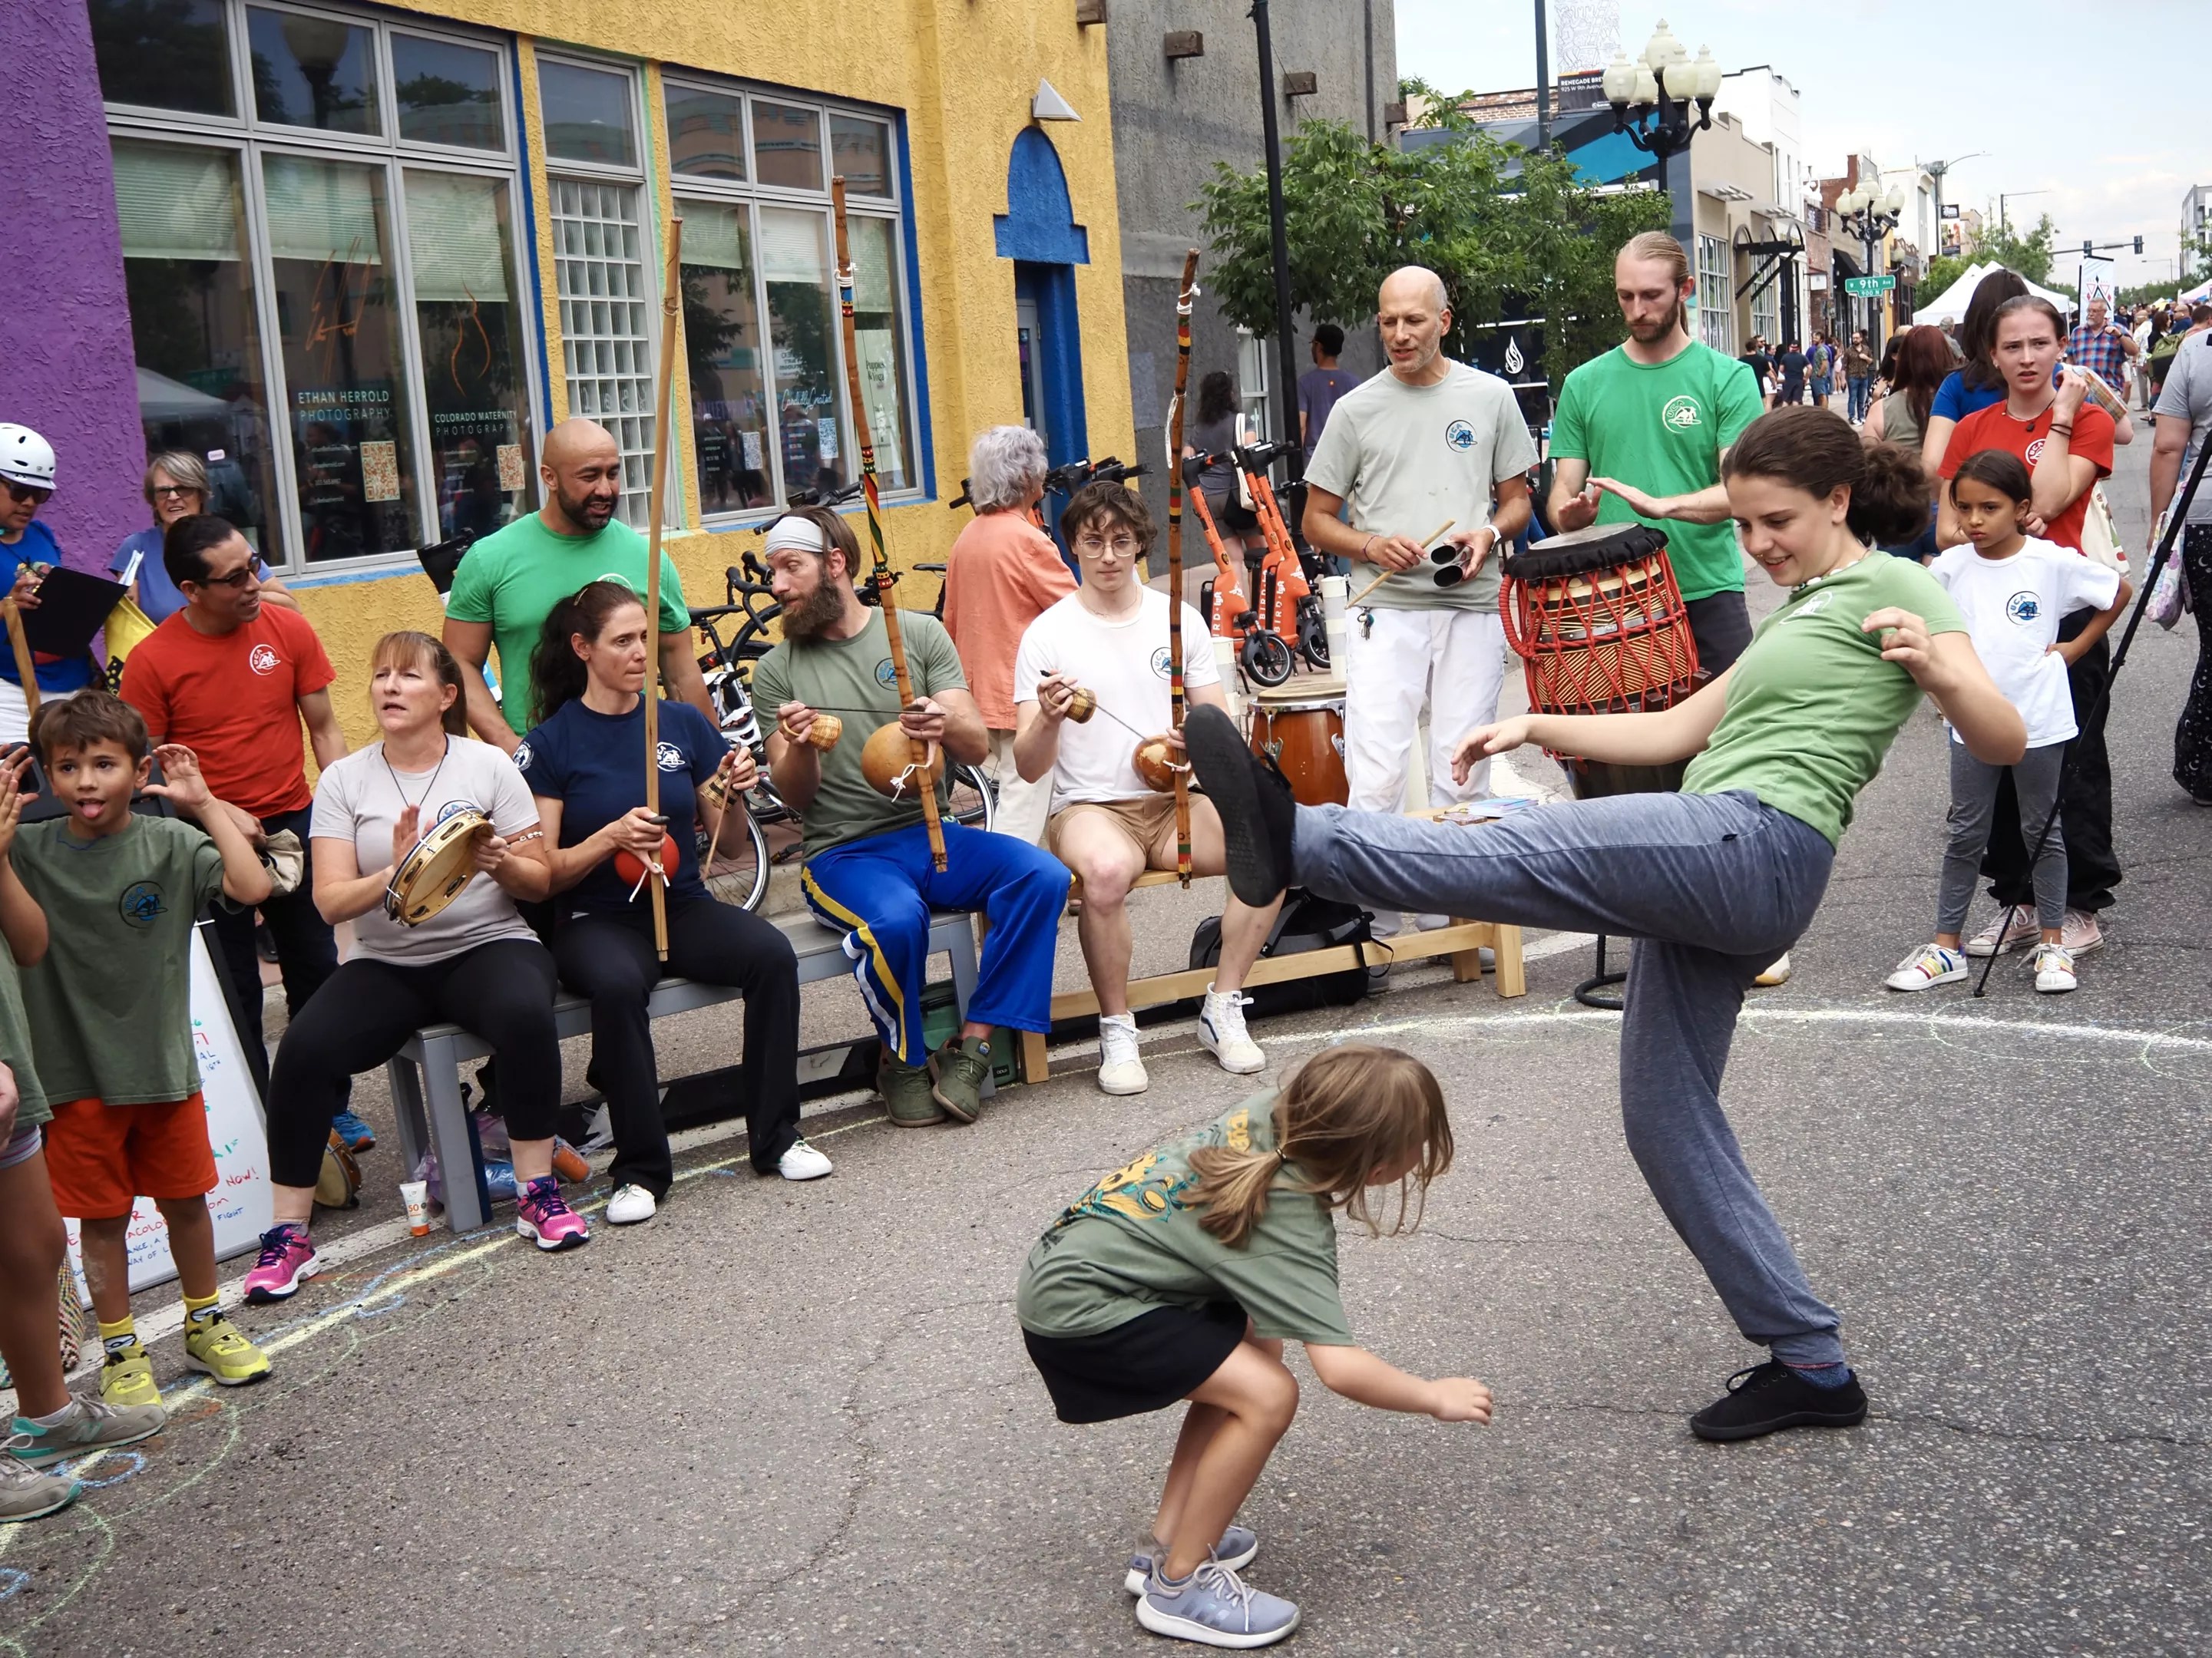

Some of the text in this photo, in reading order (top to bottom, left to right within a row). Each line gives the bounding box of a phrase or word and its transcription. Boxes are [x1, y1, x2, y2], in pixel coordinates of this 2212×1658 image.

[1860, 279, 1879, 289] 9th
[298, 391, 389, 405] ETHAN HERROLD
[300, 408, 391, 421] PHOTOGRAPHY
[435, 410, 517, 423] COLORADO MATERNITY
[2010, 595, 2027, 611] UCA
[1274, 601, 1283, 633] BIRD
[1154, 651, 1166, 666] UCA
[226, 1166, 260, 1187] NOW!
[408, 1204, 419, 1212] 50
[127, 1242, 152, 1254] ANCE,
[217, 1207, 244, 1220] FIGHT
[147, 1250, 157, 1260] OF
